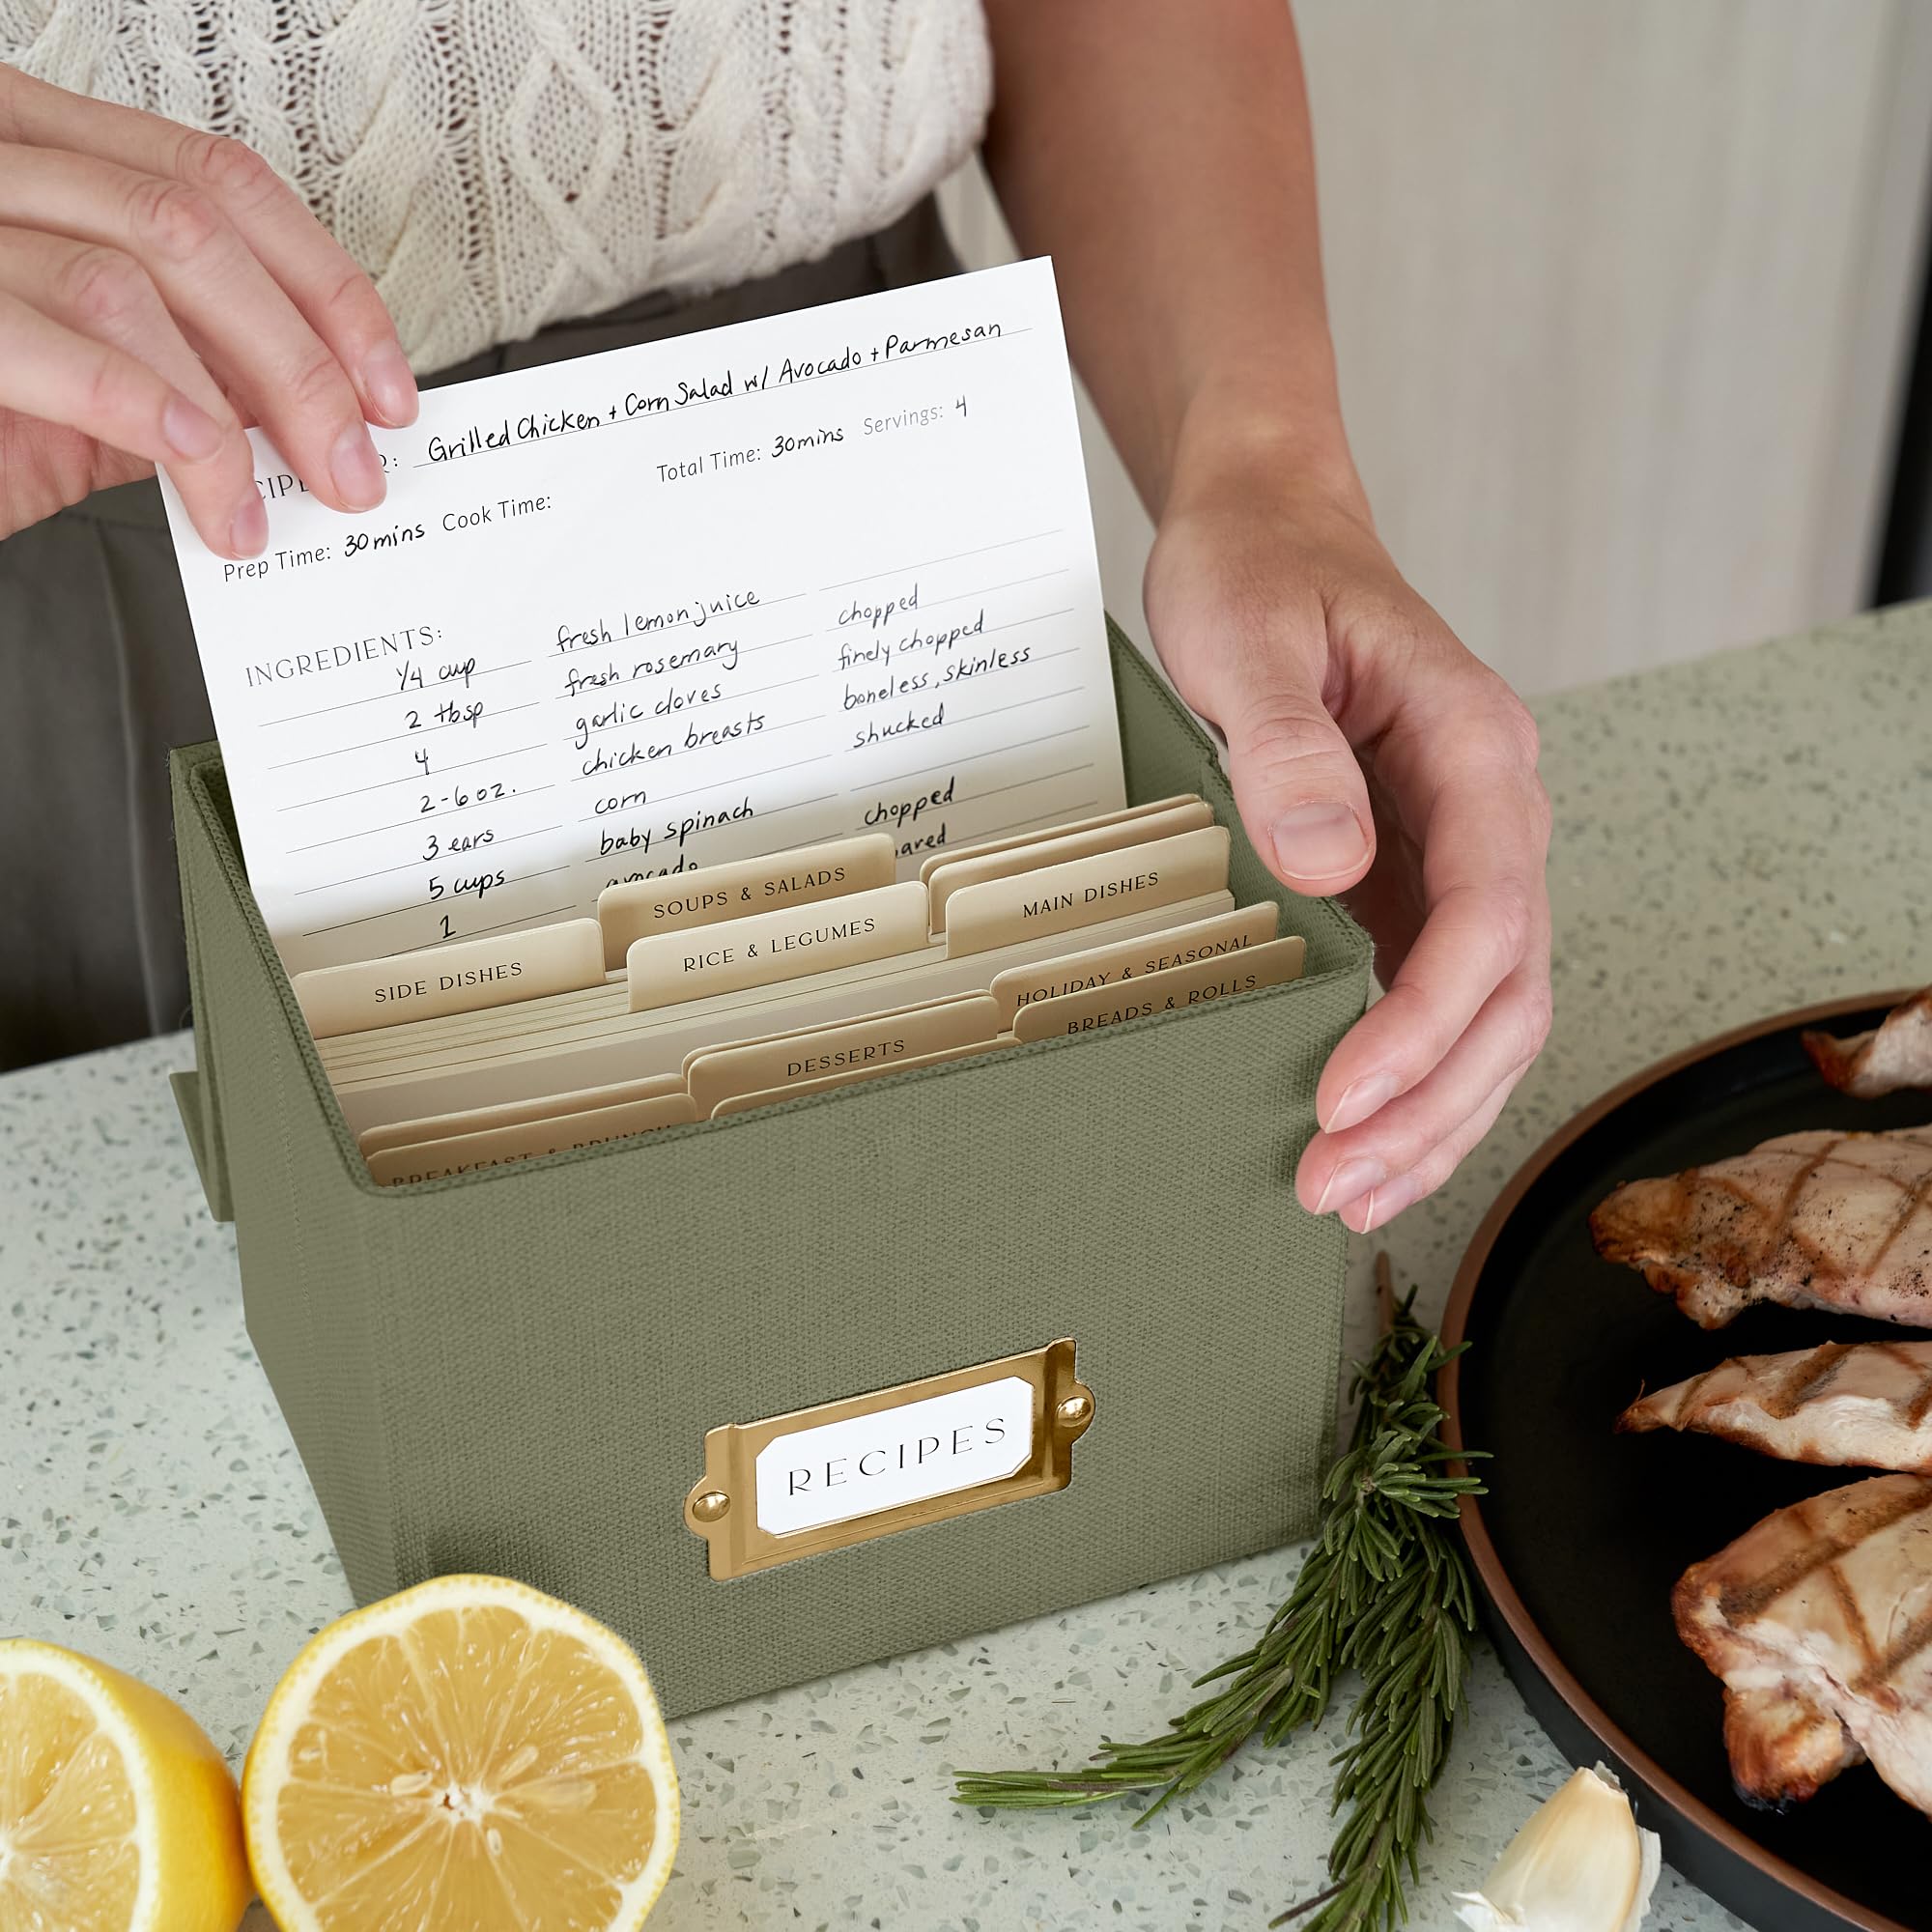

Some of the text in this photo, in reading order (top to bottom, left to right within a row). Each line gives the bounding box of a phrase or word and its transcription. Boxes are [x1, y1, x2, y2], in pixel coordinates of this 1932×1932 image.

[428, 419, 510, 464] Grilled
[516, 406, 601, 440] Chicken
[608, 405, 617, 421] +
[625, 392, 669, 416] Corn
[674, 370, 733, 406] Salad
[744, 365, 769, 391] w/
[779, 346, 862, 384] Avocado
[869, 347, 880, 363] +
[885, 321, 1002, 360] Parmesan
[863, 403, 944, 437] Servings:
[954, 394, 968, 418] 4
[657, 444, 761, 483] Total Time:
[441, 493, 553, 532] Cook Time:
[223, 544, 332, 582] Prep Time:
[244, 625, 443, 688] INGREDIENTS:
[404, 582, 919, 729] 2 tbsp fresh rosemary chopped
[439, 657, 476, 689] cup
[555, 618, 612, 653] fresh
[624, 608, 690, 637] lemon
[693, 588, 760, 628] juice
[414, 608, 984, 776] 4 garlic cloves finely chopped
[582, 742, 673, 776] chicken
[684, 712, 766, 750] breasts
[422, 701, 945, 862] 3 ears corn shucked
[428, 795, 754, 900] 5 cups baby spinach
[439, 914, 457, 940] 1
[864, 776, 955, 828] chopped
[653, 867, 846, 920] SOUPS & SALADS
[1022, 871, 1160, 920] MAIN DISHES
[682, 918, 876, 974] RICE & LEGUMES
[1016, 934, 1253, 1008] HOLIDAY & SEASONAL
[374, 961, 525, 1004] SIDE DISHES
[1066, 975, 1257, 1036] BREADS & ROLLS
[786, 1038, 906, 1078] DESSERTS
[787, 1416, 1007, 1496] RECIPES
